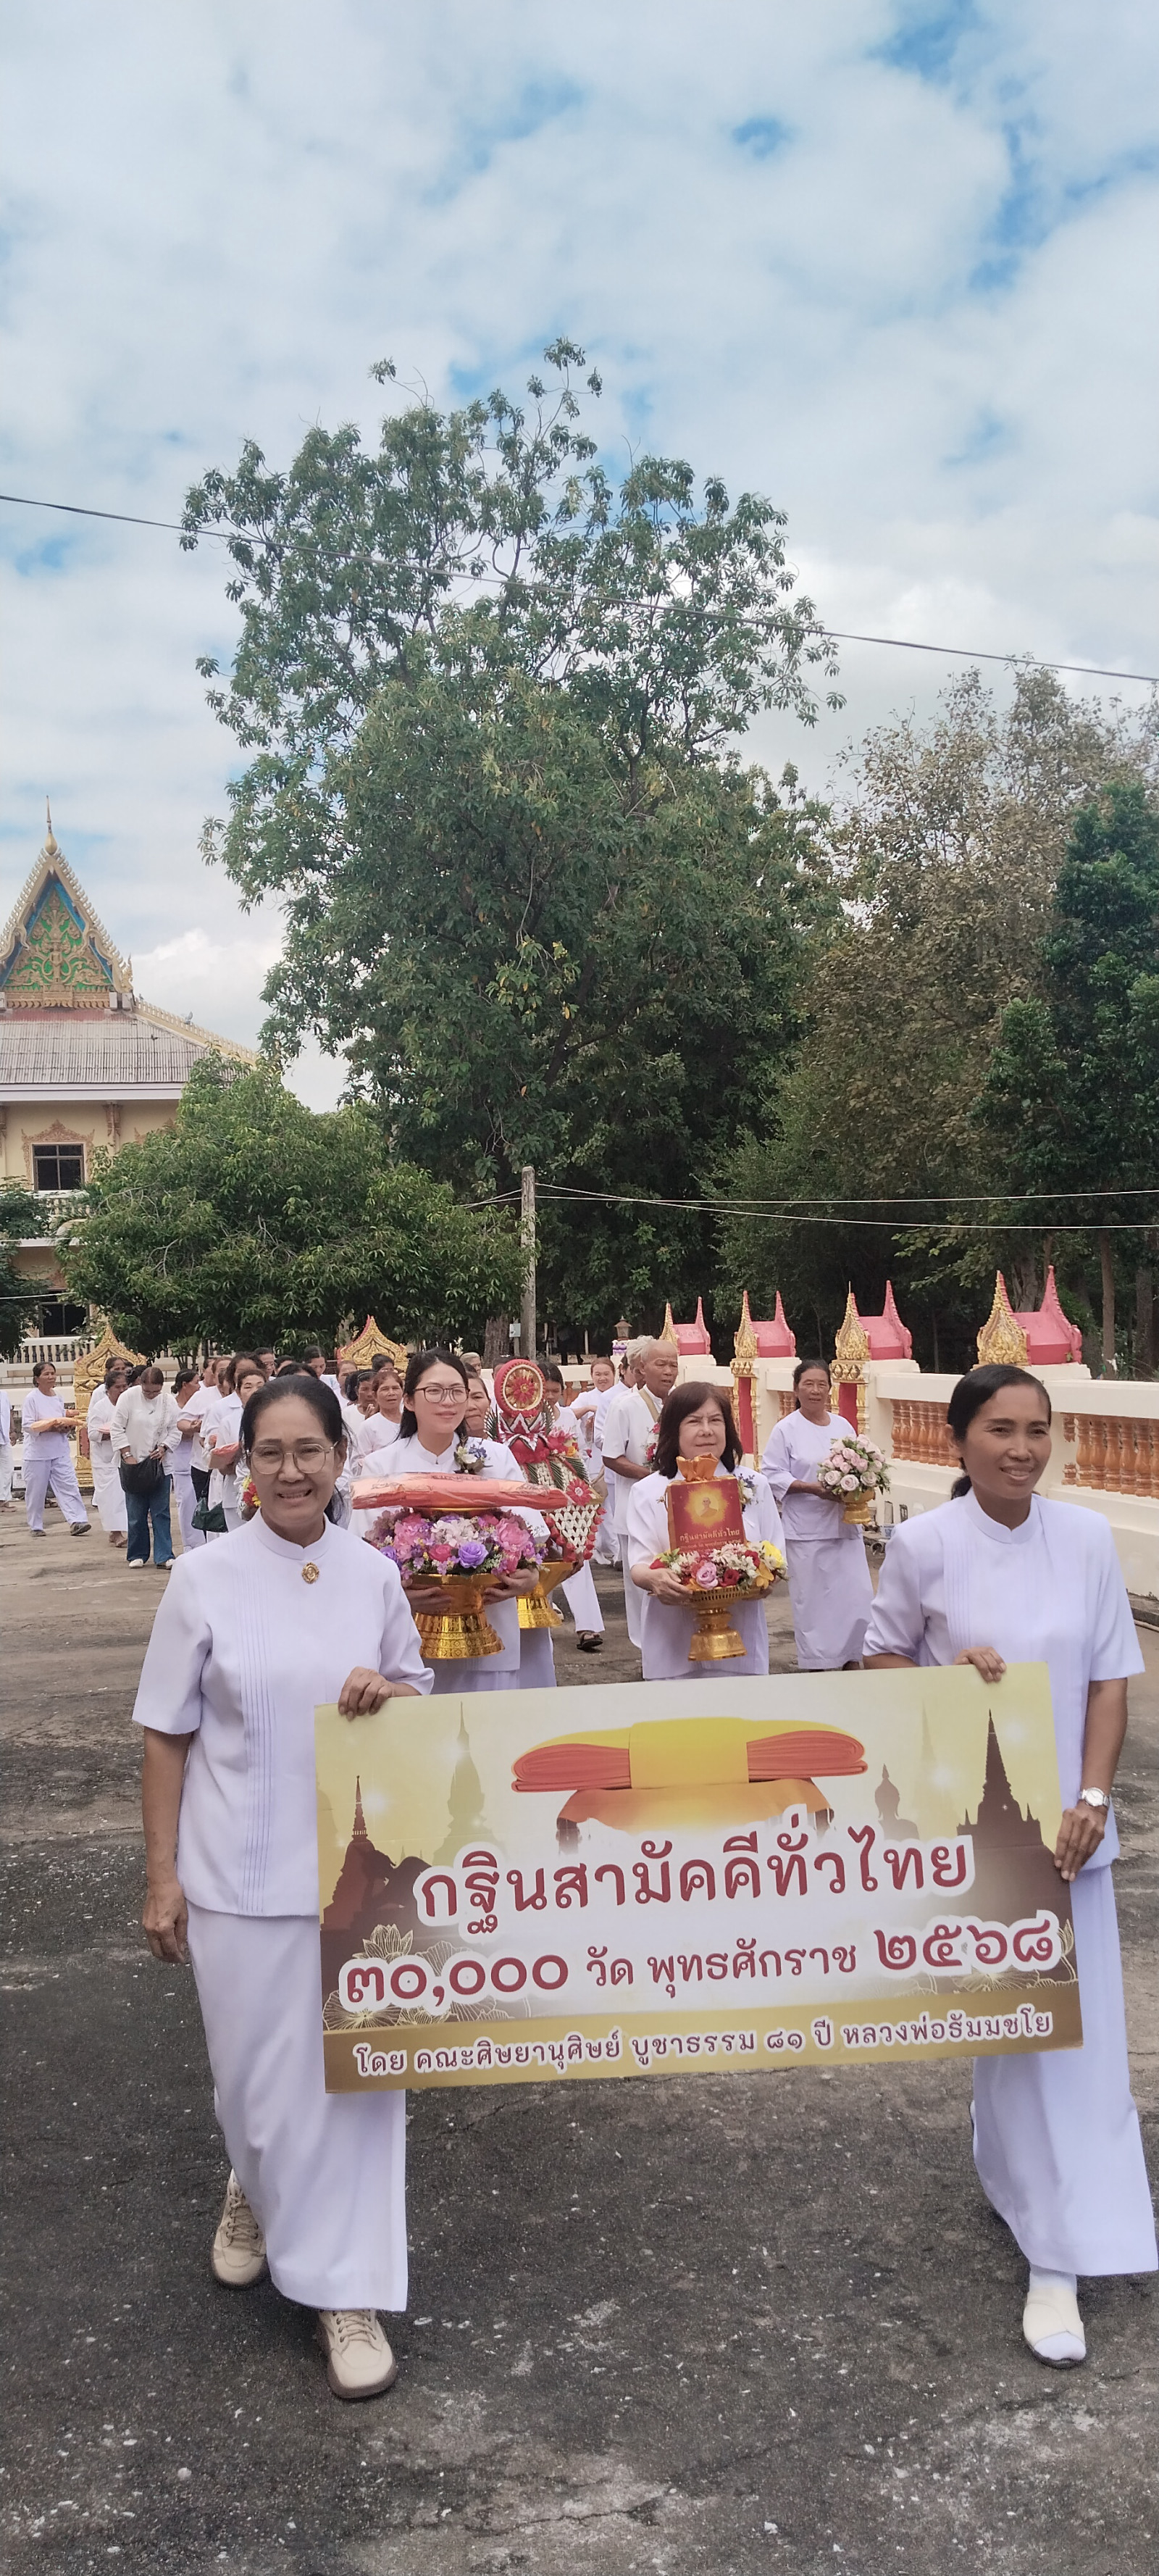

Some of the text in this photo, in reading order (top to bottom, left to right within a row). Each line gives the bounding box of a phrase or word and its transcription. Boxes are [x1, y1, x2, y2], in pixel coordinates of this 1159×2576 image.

[421, 1812, 968, 1935] กฐินสามัคคีทั่วไทย
[346, 1919, 1054, 2006] ๓๐,๐๐๐ วัด พุทธศักราช ๒๕๖๘
[356, 2007, 1051, 2073] โดย คณะศิษยานุศิษย์ บูชาธรรม ๘๑ ปี หลวงพ่อธัมมชโย
